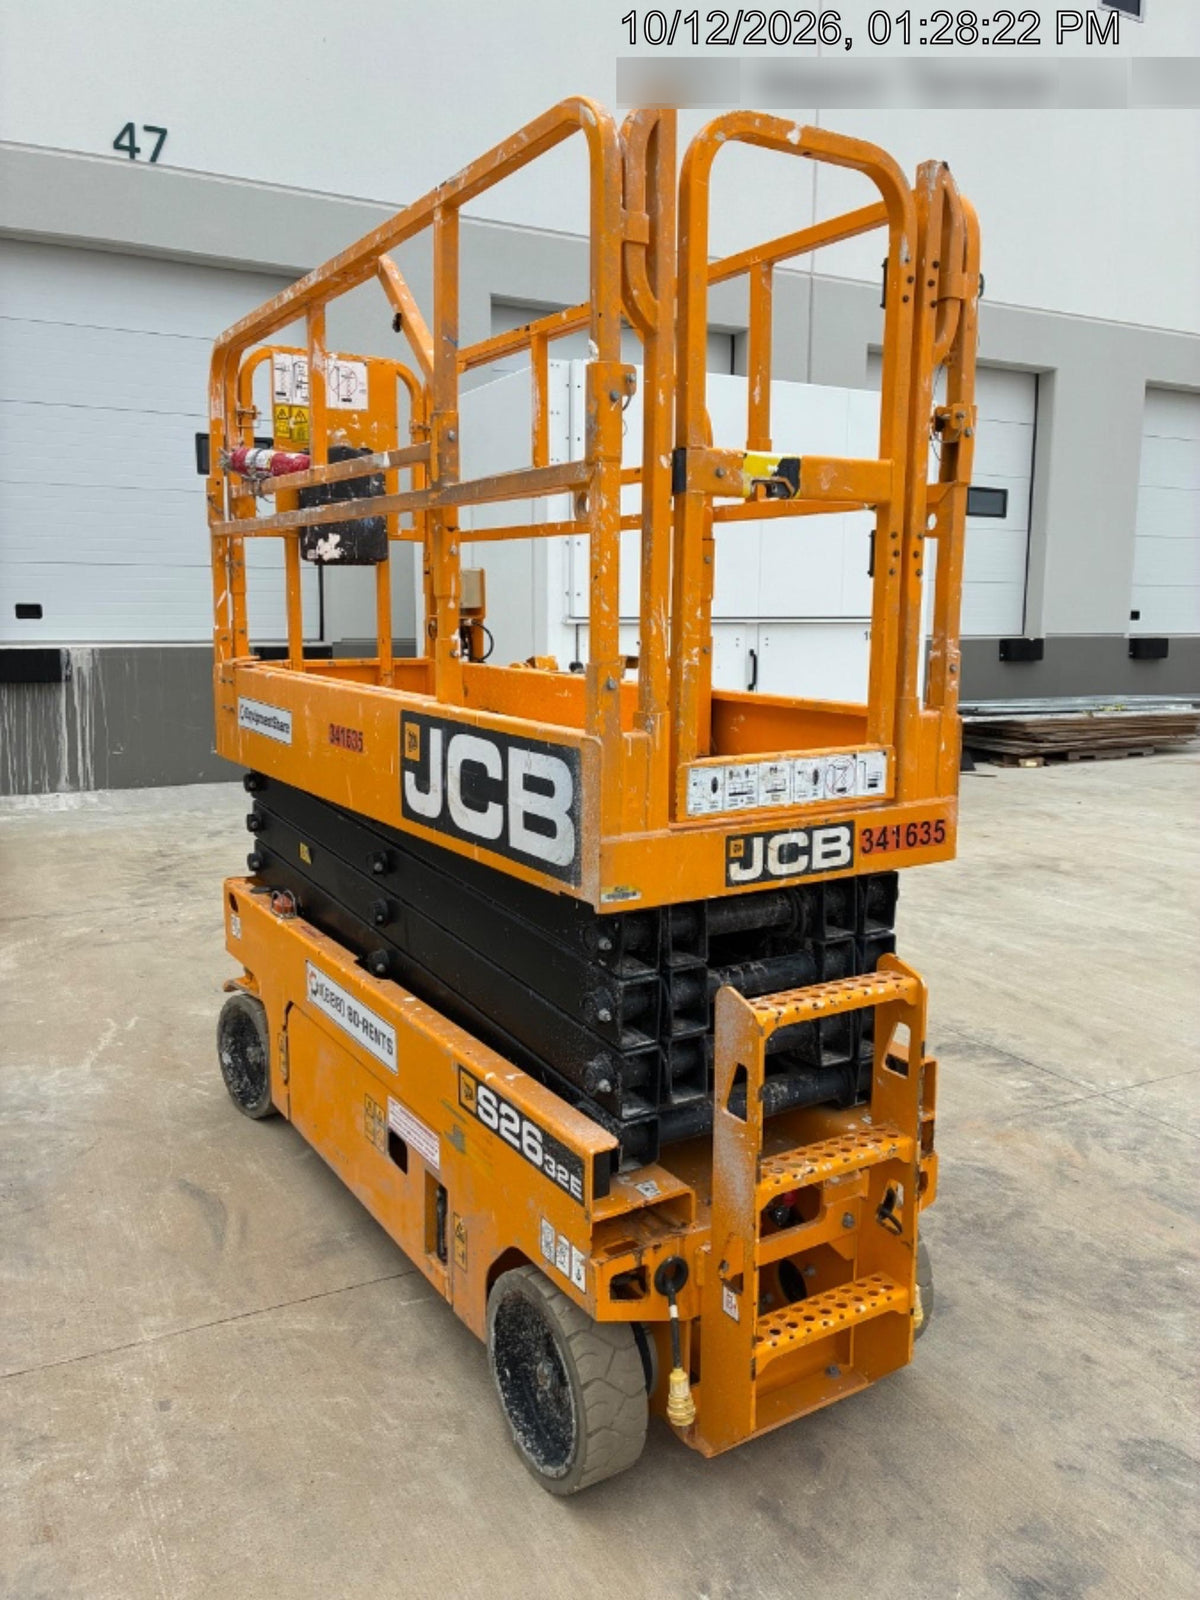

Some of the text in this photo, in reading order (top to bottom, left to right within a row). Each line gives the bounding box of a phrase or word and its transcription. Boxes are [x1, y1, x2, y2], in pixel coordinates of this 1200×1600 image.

[113, 122, 167, 163] 47
[404, 726, 576, 867] JCB
[729, 826, 851, 881] JCB
[861, 819, 946, 854] 341635
[346, 1004, 394, 1056] 80-RENTS
